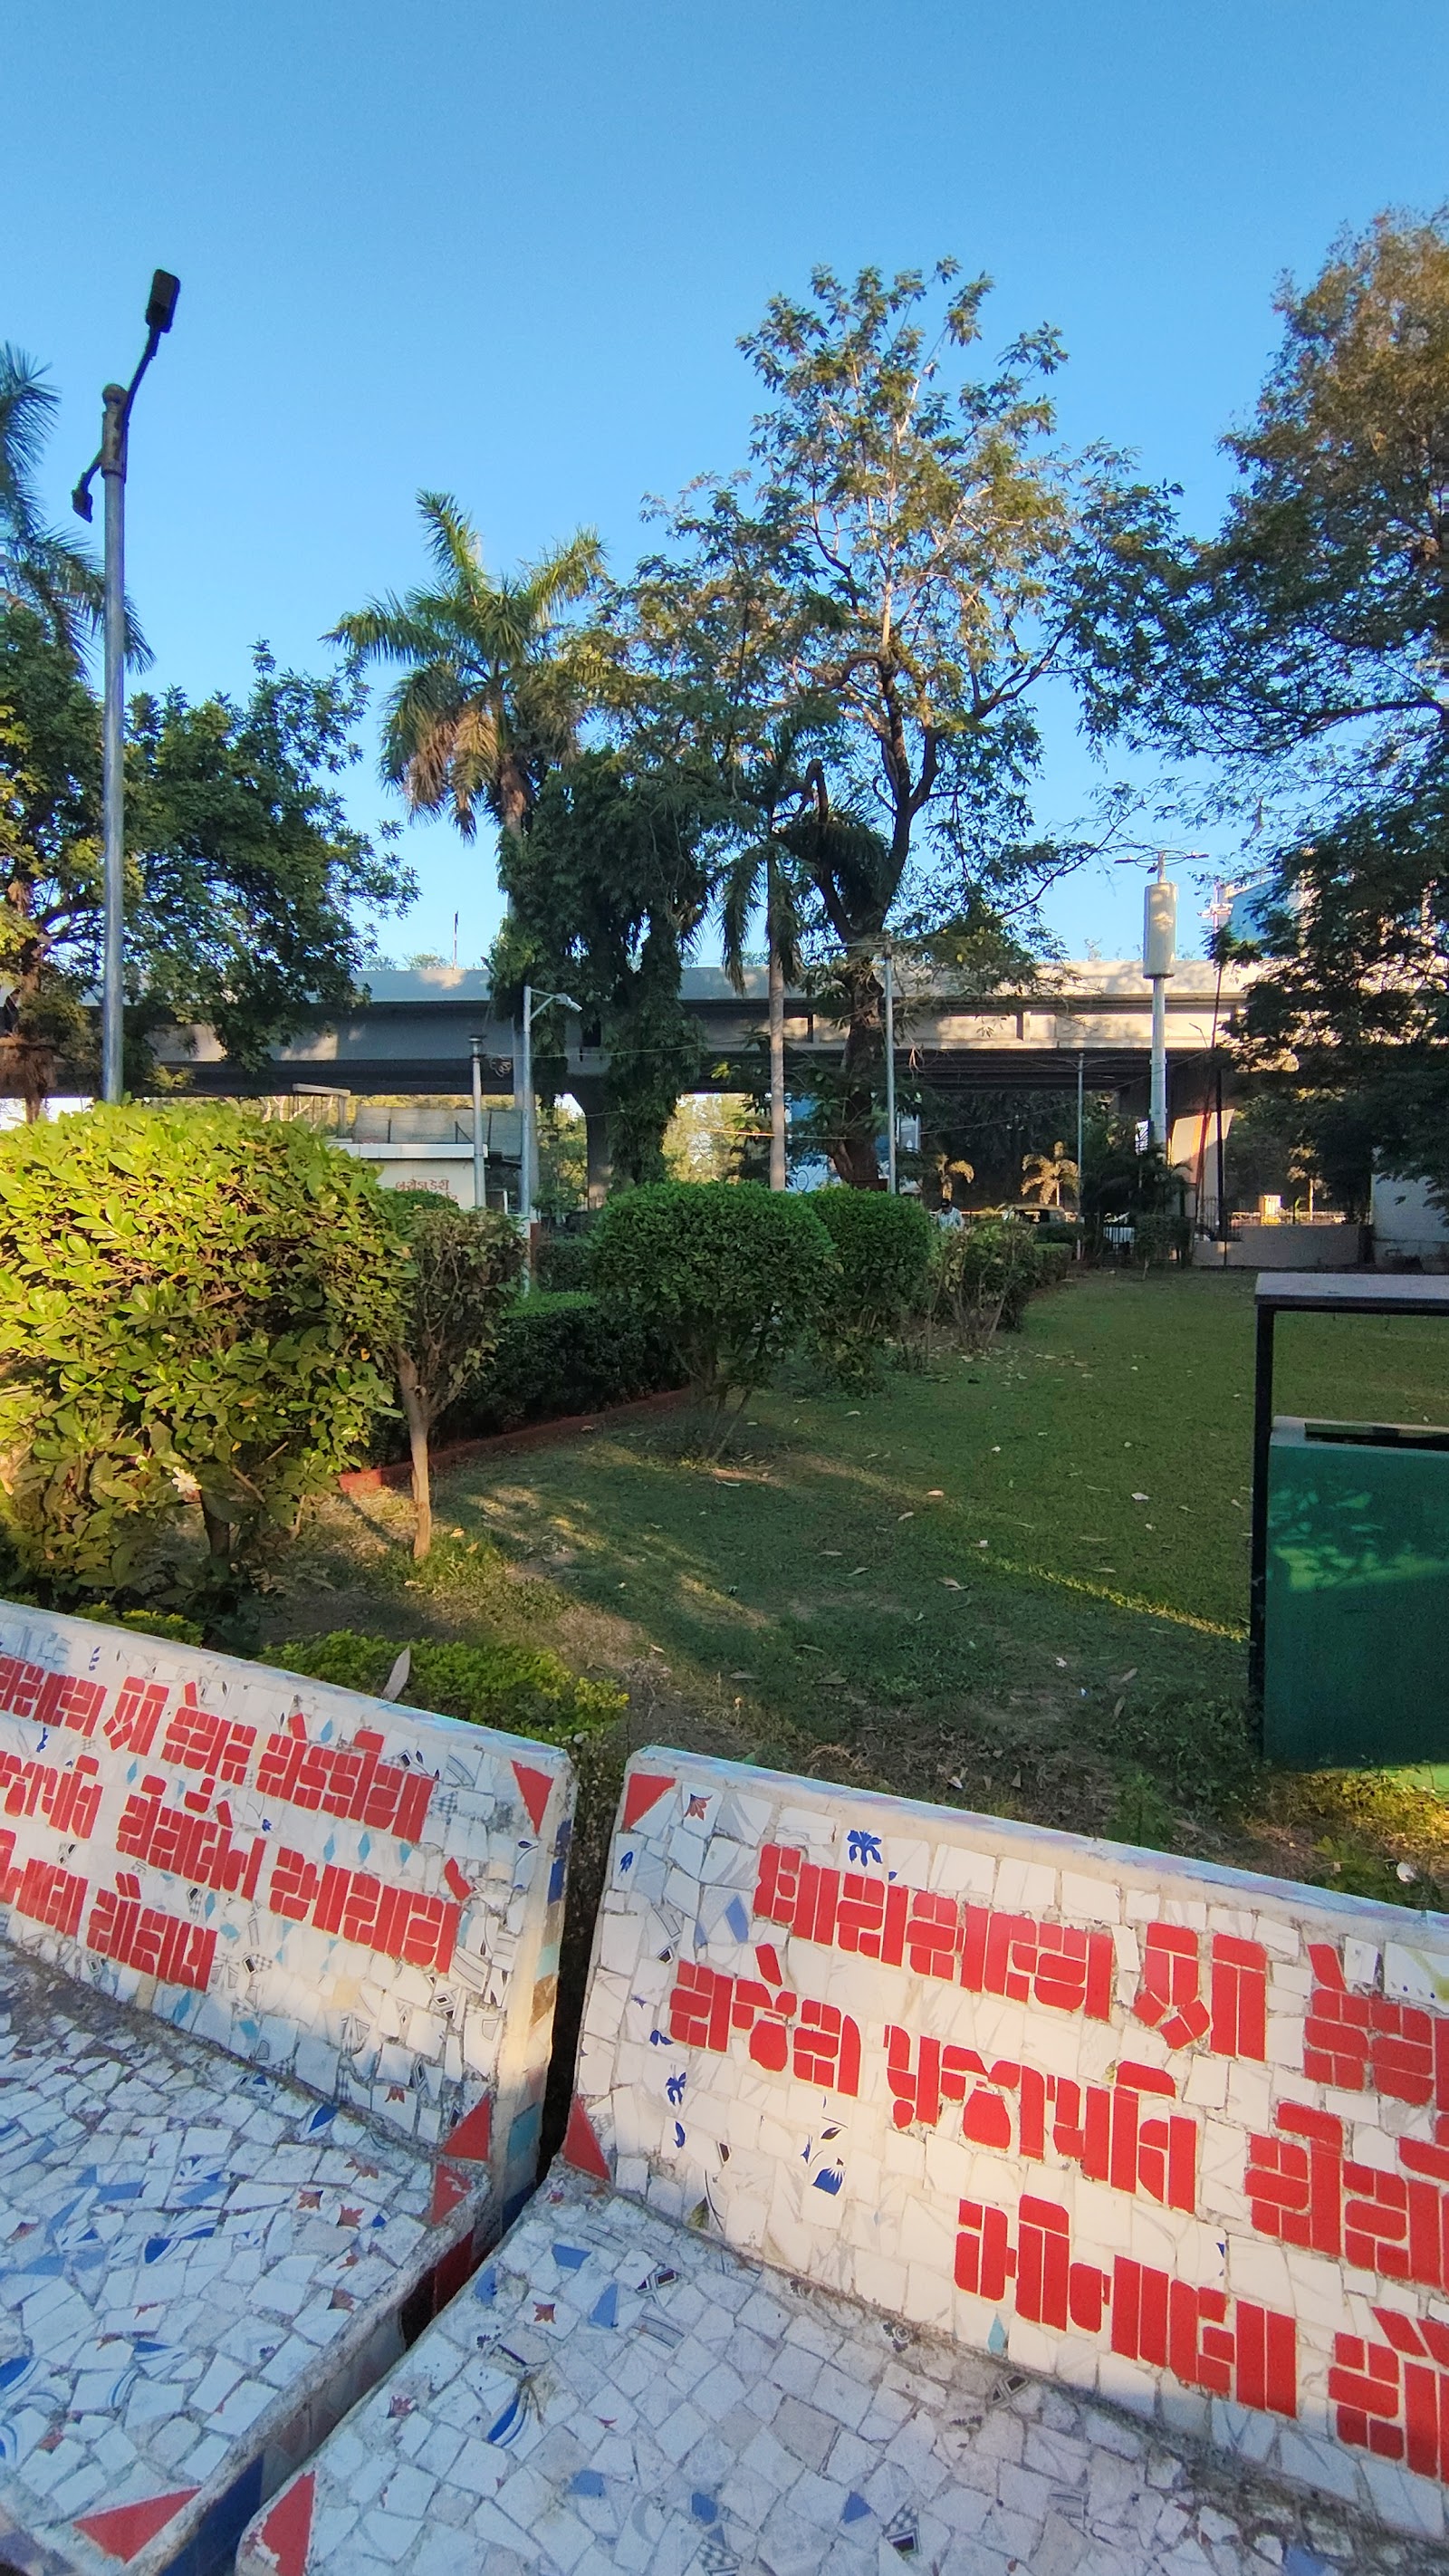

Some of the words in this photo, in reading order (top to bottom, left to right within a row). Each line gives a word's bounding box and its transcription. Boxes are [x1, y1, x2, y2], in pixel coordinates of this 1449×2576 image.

[396, 1178, 427, 1191] બરોડા
[429, 1179, 450, 1191] ડેરી
[105, 1677, 168, 1755] શ્રી
[753, 1844, 1114, 2020] ધારાસભ્ય
[1132, 1922, 1267, 2061] શ્રી
[670, 1944, 860, 2094] રાજેશ
[884, 2025, 1197, 2212] પ્રજાપતિ
